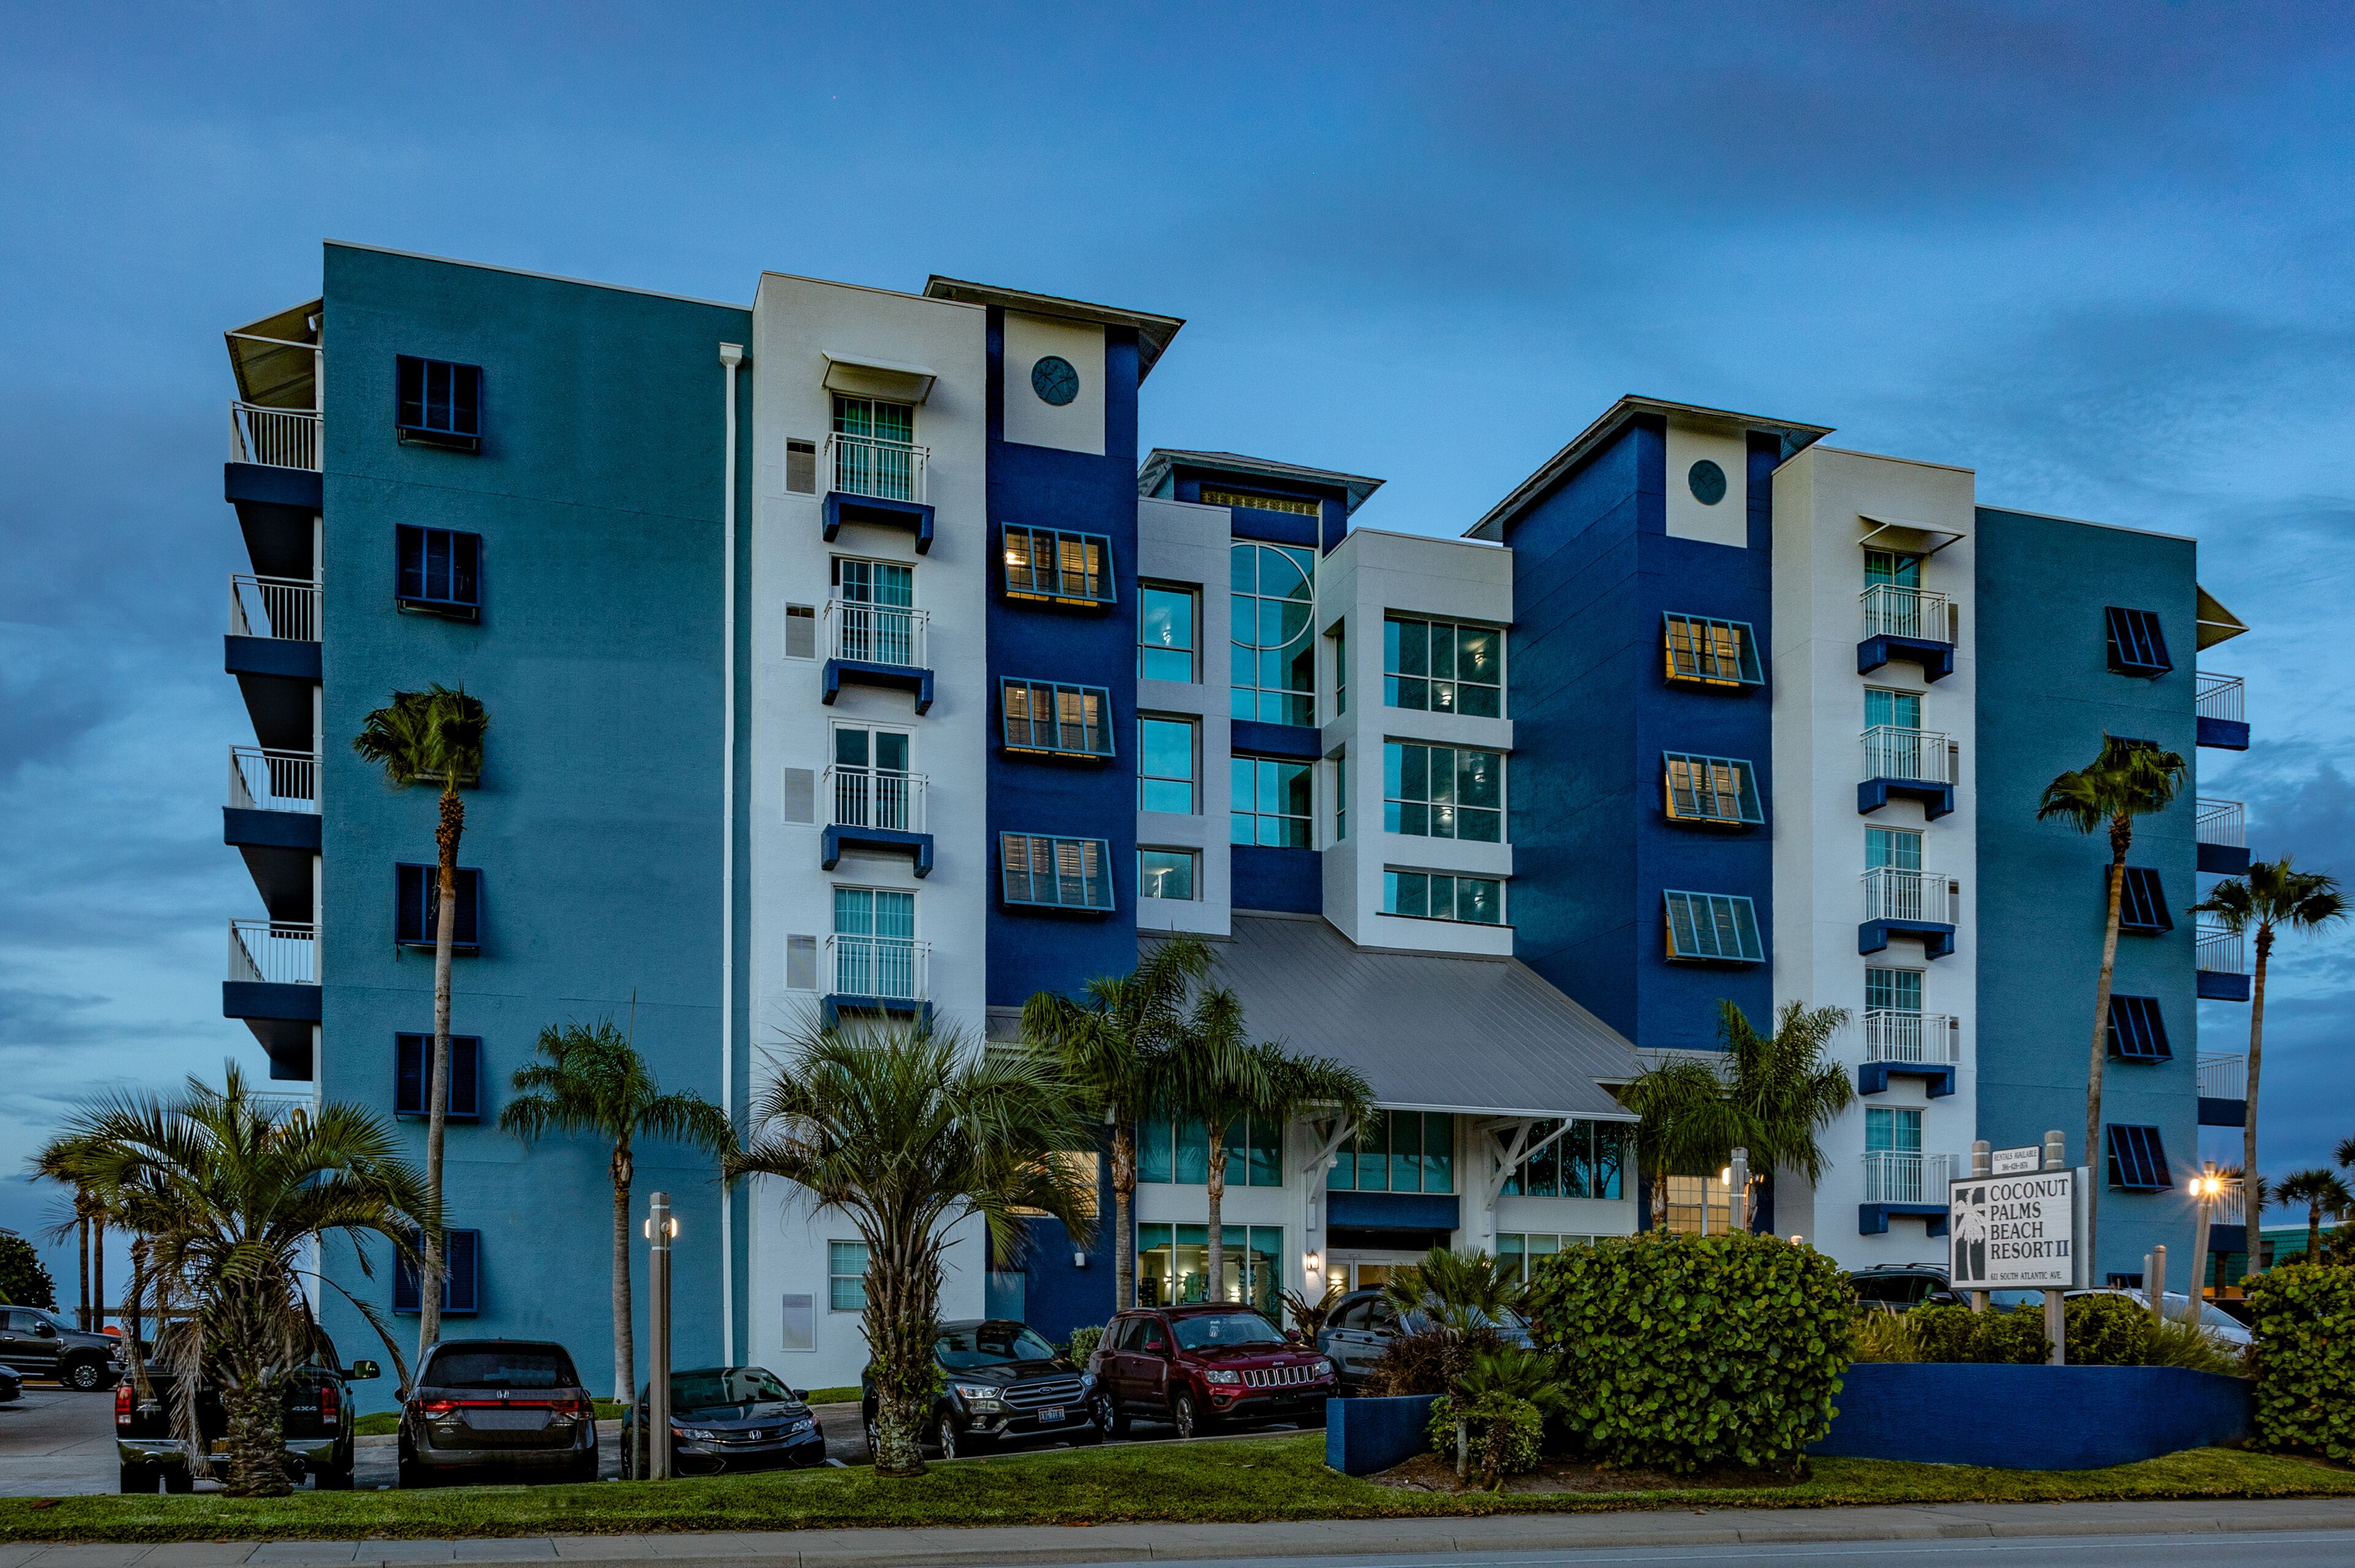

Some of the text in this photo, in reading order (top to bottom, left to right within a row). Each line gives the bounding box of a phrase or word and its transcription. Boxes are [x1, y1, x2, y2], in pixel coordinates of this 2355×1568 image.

[2014, 1150, 2037, 1158] AVAILABLE
[1990, 1179, 2068, 1201] COCONUT
[1990, 1201, 2042, 1221] PALMS
[1990, 1222, 2043, 1240] BEACH
[1990, 1240, 2070, 1260] RESORT II
[1999, 1272, 2019, 1280] SOUTH
[2020, 1271, 2048, 1280] ATLANTIC
